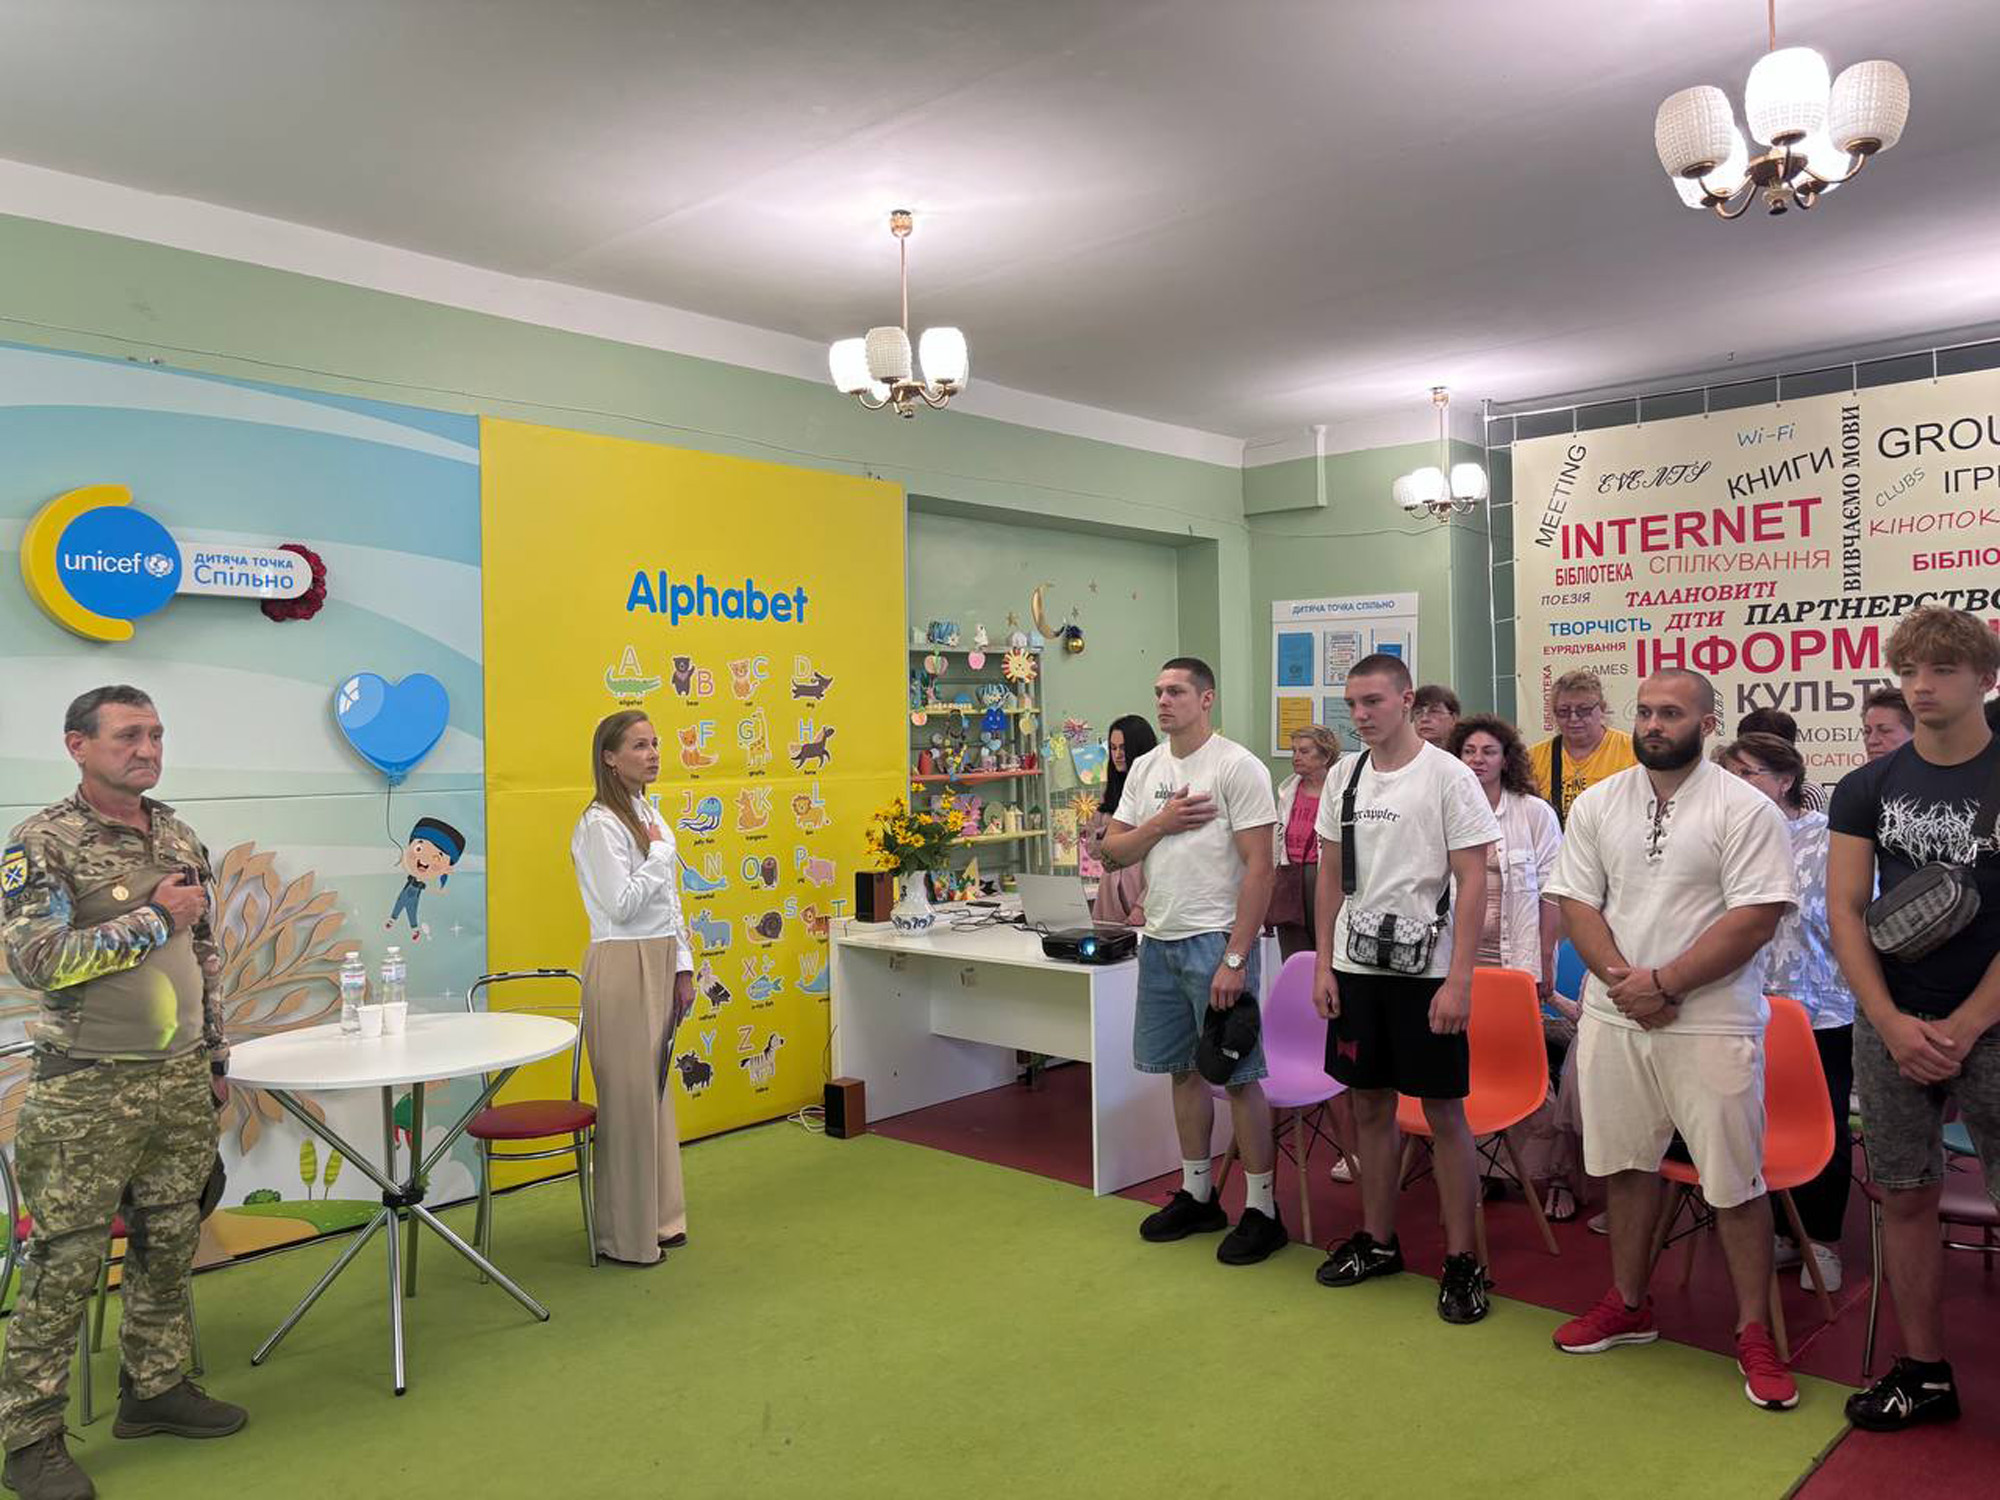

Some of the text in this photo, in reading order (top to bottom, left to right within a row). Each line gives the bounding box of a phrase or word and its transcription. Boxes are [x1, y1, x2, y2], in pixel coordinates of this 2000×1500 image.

[1737, 423, 1796, 446] Wi-Fi
[1598, 460, 1711, 494] EVENTS
[1727, 447, 1834, 499] КНИГИ
[1944, 465, 2000, 494] ІГР
[1535, 444, 1587, 547] MEETING
[1842, 405, 1861, 592] ВИВЧАЄМО МОВИ
[1875, 467, 1925, 507] CLUBS
[1562, 497, 1823, 560] INTERNET
[64, 550, 142, 574] unicef
[194, 553, 293, 569] ДИТЯЧА ТОЧКА
[1650, 550, 1831, 574] СПІЛКУВАННЯ
[194, 565, 294, 590] Спільно
[1555, 563, 1634, 586] БІБЛІОТЕКА
[626, 570, 808, 626] Alphabet
[1541, 592, 1591, 606] ПОЕЗІЯ
[1625, 581, 1777, 608] ТАЛАНОВИТІ
[1292, 604, 1325, 615] ДИТЯЧА
[1327, 602, 1354, 612] ТОЧКА
[1550, 617, 1652, 637] ТВОРЧІСТЬ
[1664, 610, 1725, 633] ДІТИ
[618, 647, 642, 676] A
[752, 656, 770, 680] C
[795, 656, 812, 677] D
[697, 670, 713, 696] B
[1738, 678, 1893, 714] КУЛЬТ
[699, 720, 715, 748] F
[738, 720, 754, 740] G
[799, 719, 814, 742] H
[682, 791, 694, 813] J
[811, 782, 826, 806] L
[705, 853, 721, 877] N
[741, 856, 761, 882] O
[796, 847, 808, 870] P
[785, 898, 799, 919] S
[831, 899, 846, 917] T
[742, 957, 757, 981] X
[701, 1030, 718, 1054] Y
[737, 1025, 755, 1053] Z
